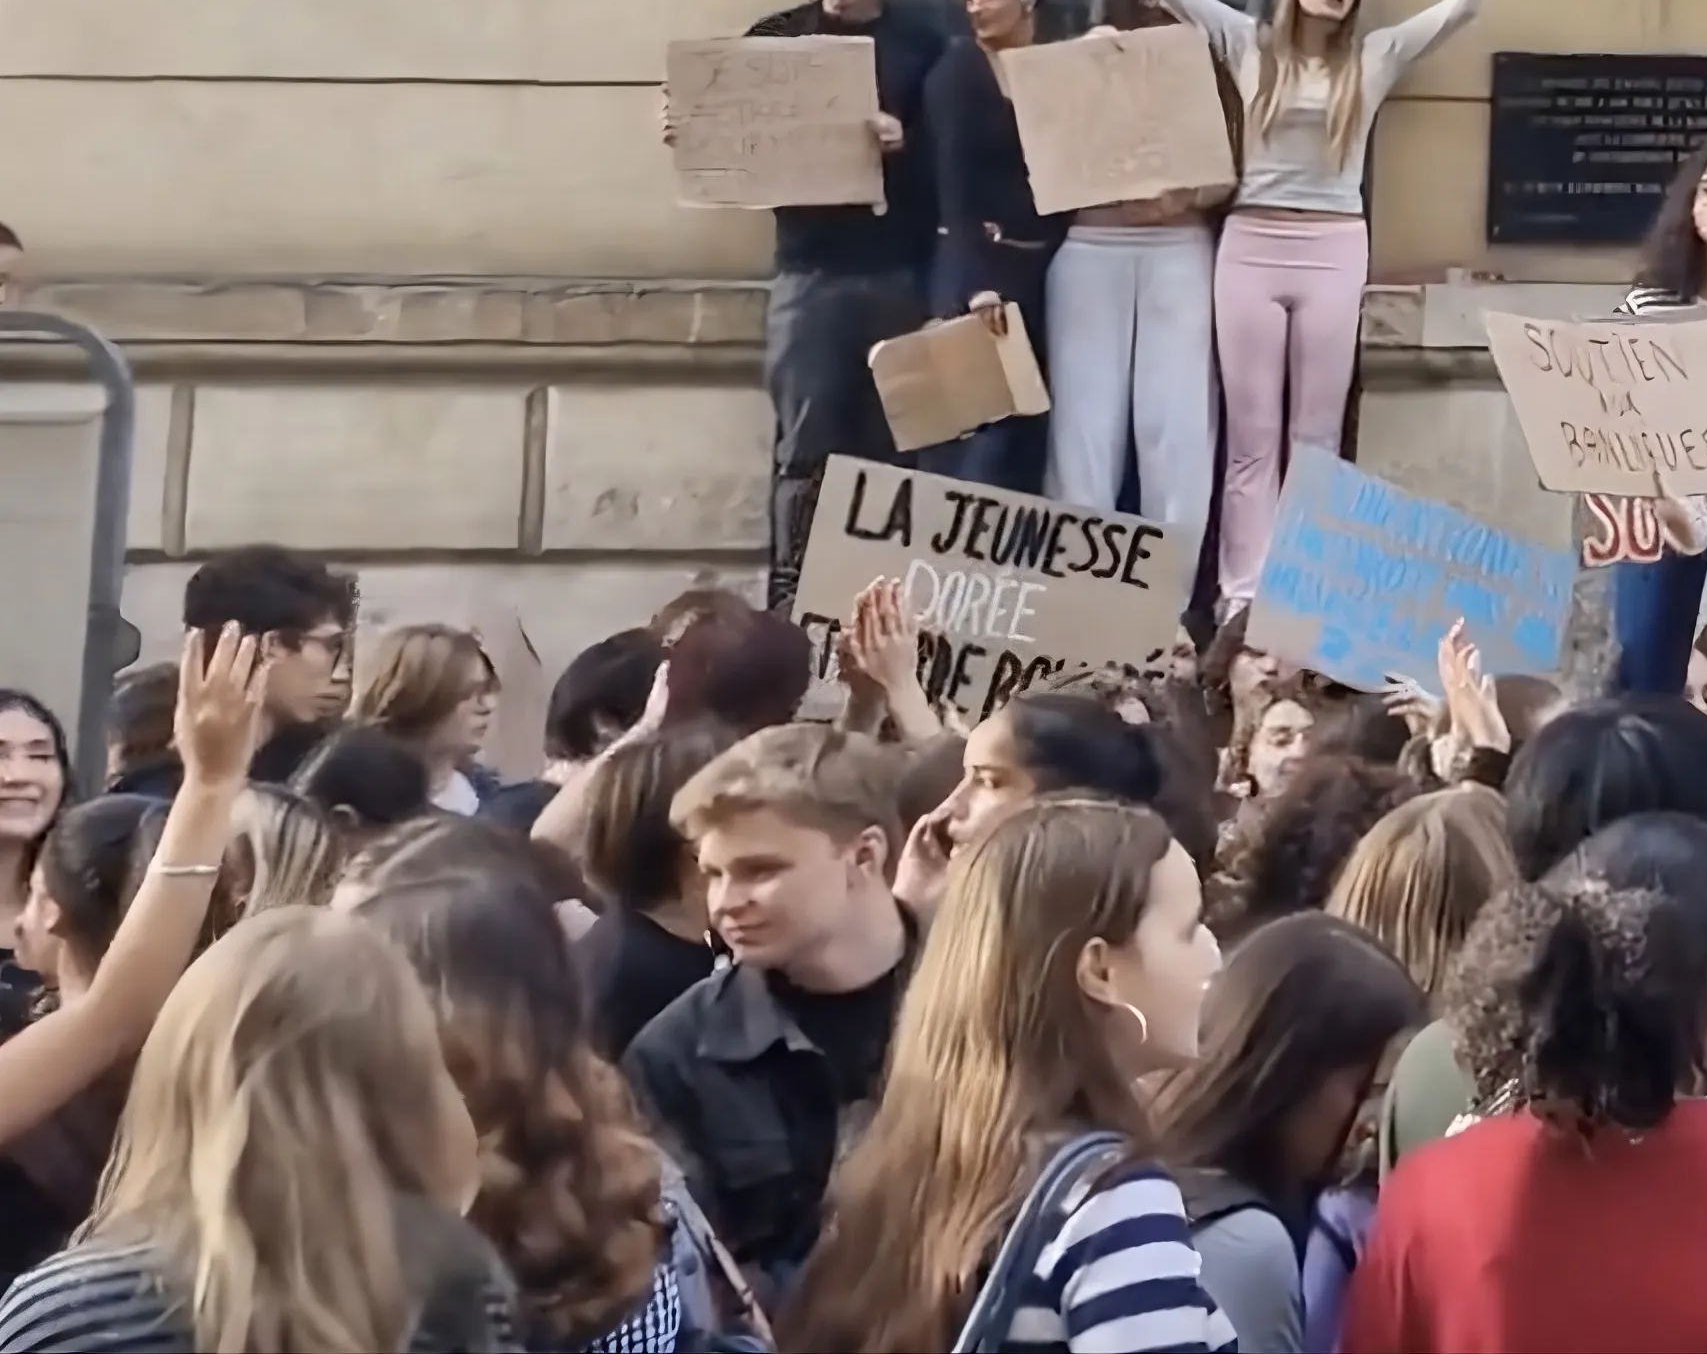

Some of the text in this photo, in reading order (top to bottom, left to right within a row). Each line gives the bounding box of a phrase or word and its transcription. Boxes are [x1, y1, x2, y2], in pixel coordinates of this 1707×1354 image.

[1524, 322, 1689, 386] SOUTIEN
[845, 469, 914, 548] LA
[931, 490, 1164, 589] JEUNESSE
[904, 558, 1048, 644] DORÉE
